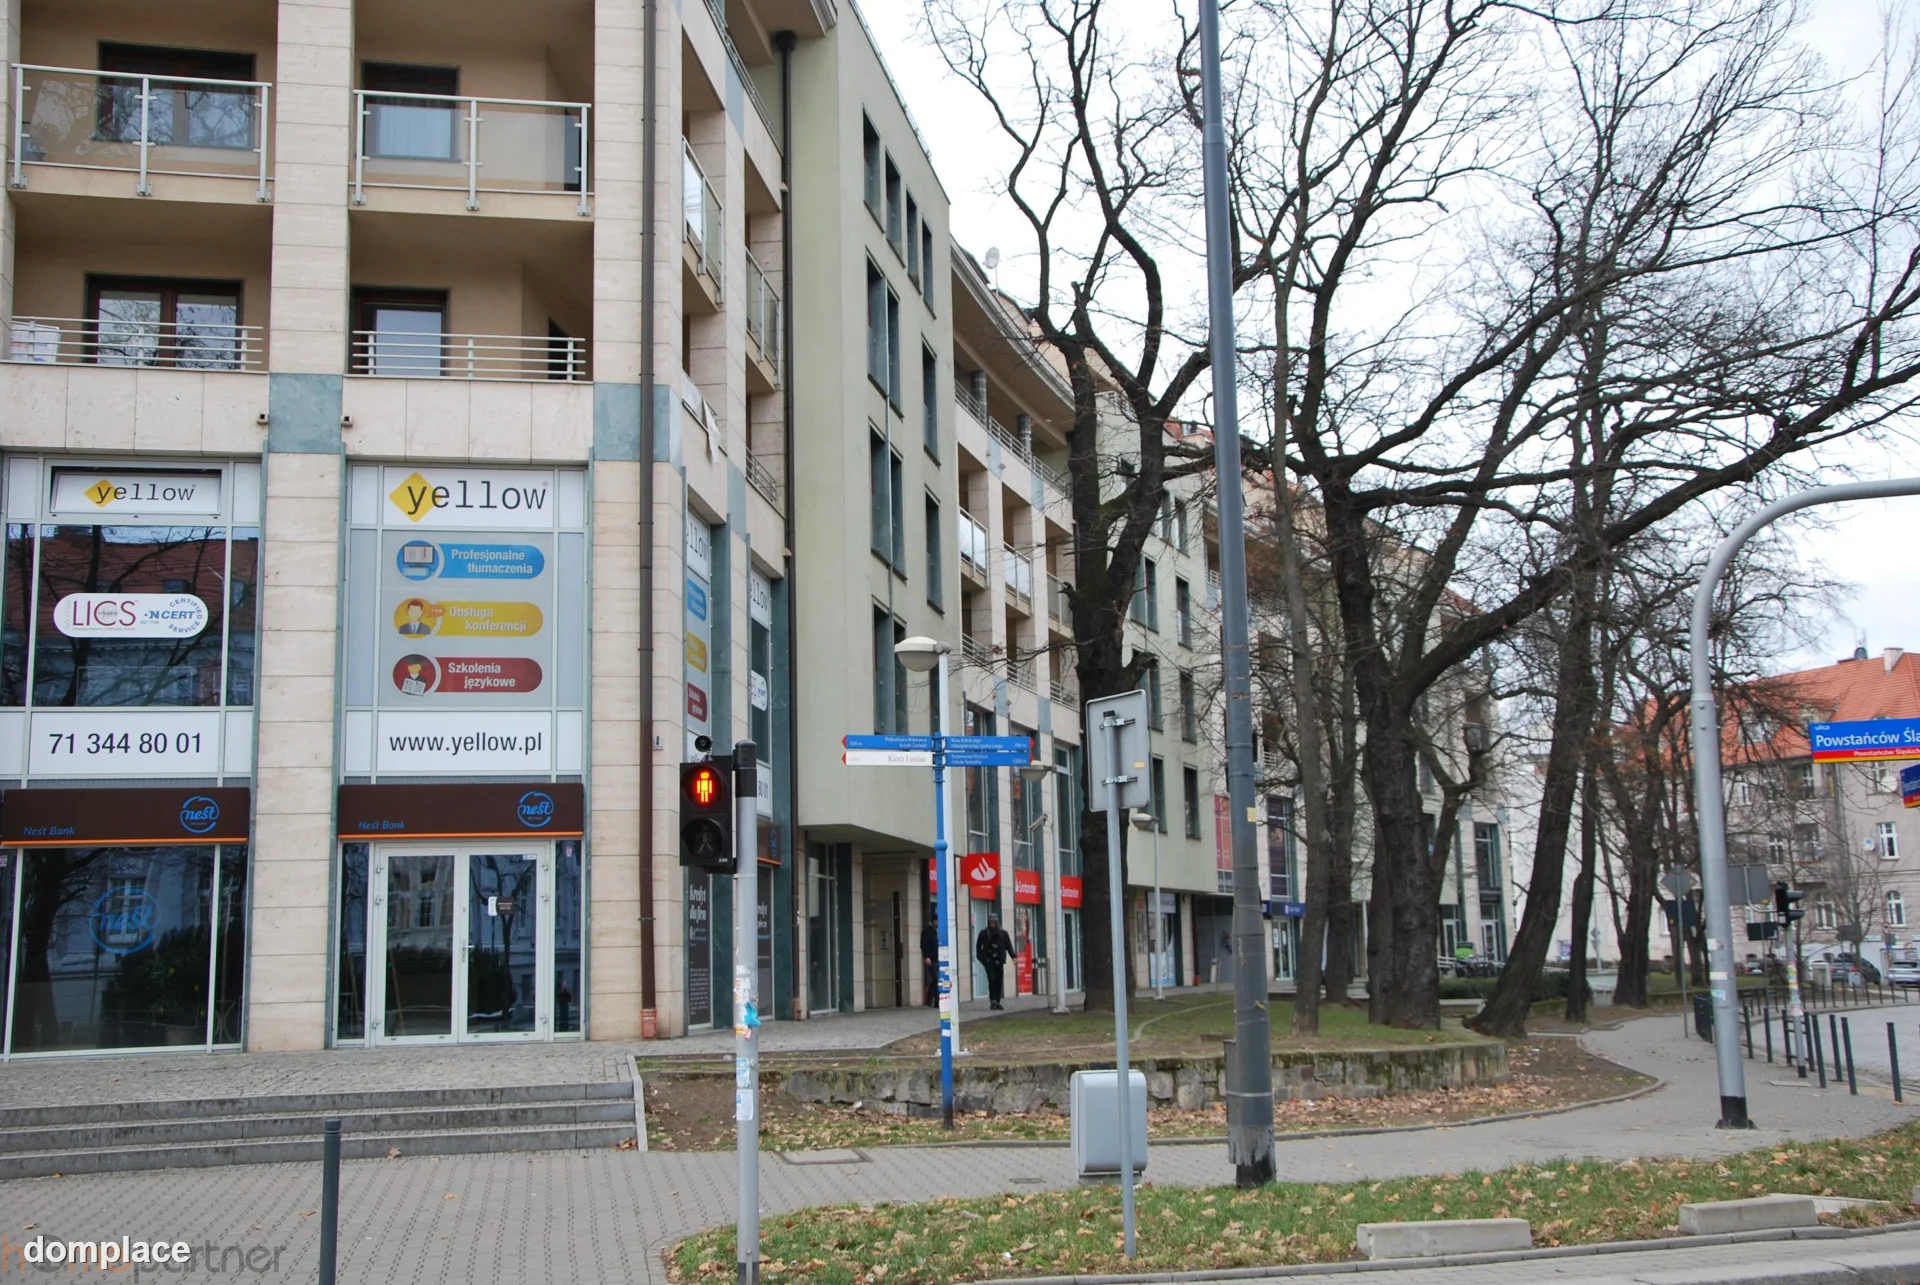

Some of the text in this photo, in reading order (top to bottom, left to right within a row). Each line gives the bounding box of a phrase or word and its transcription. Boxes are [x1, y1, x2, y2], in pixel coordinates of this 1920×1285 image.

[96, 483, 195, 504] yellow
[407, 480, 547, 515] yellow
[451, 549, 525, 561] Profesjonalne
[467, 562, 533, 574] tłumaczenia
[72, 600, 136, 626] LICS
[449, 606, 493, 619] Obsługa
[465, 620, 527, 633] konferencji
[448, 662, 501, 674] Szkolenia
[464, 676, 516, 690] językowe
[49, 732, 201, 754] 71 344 80 01
[389, 732, 542, 755] www.yellow.pl
[1816, 730, 1900, 747] Powstańców
[888, 755, 926, 763] Kino Lwów
[1853, 749, 1894, 757] Powstańców
[50, 826, 75, 836] Bank
[382, 820, 406, 829] Bank
